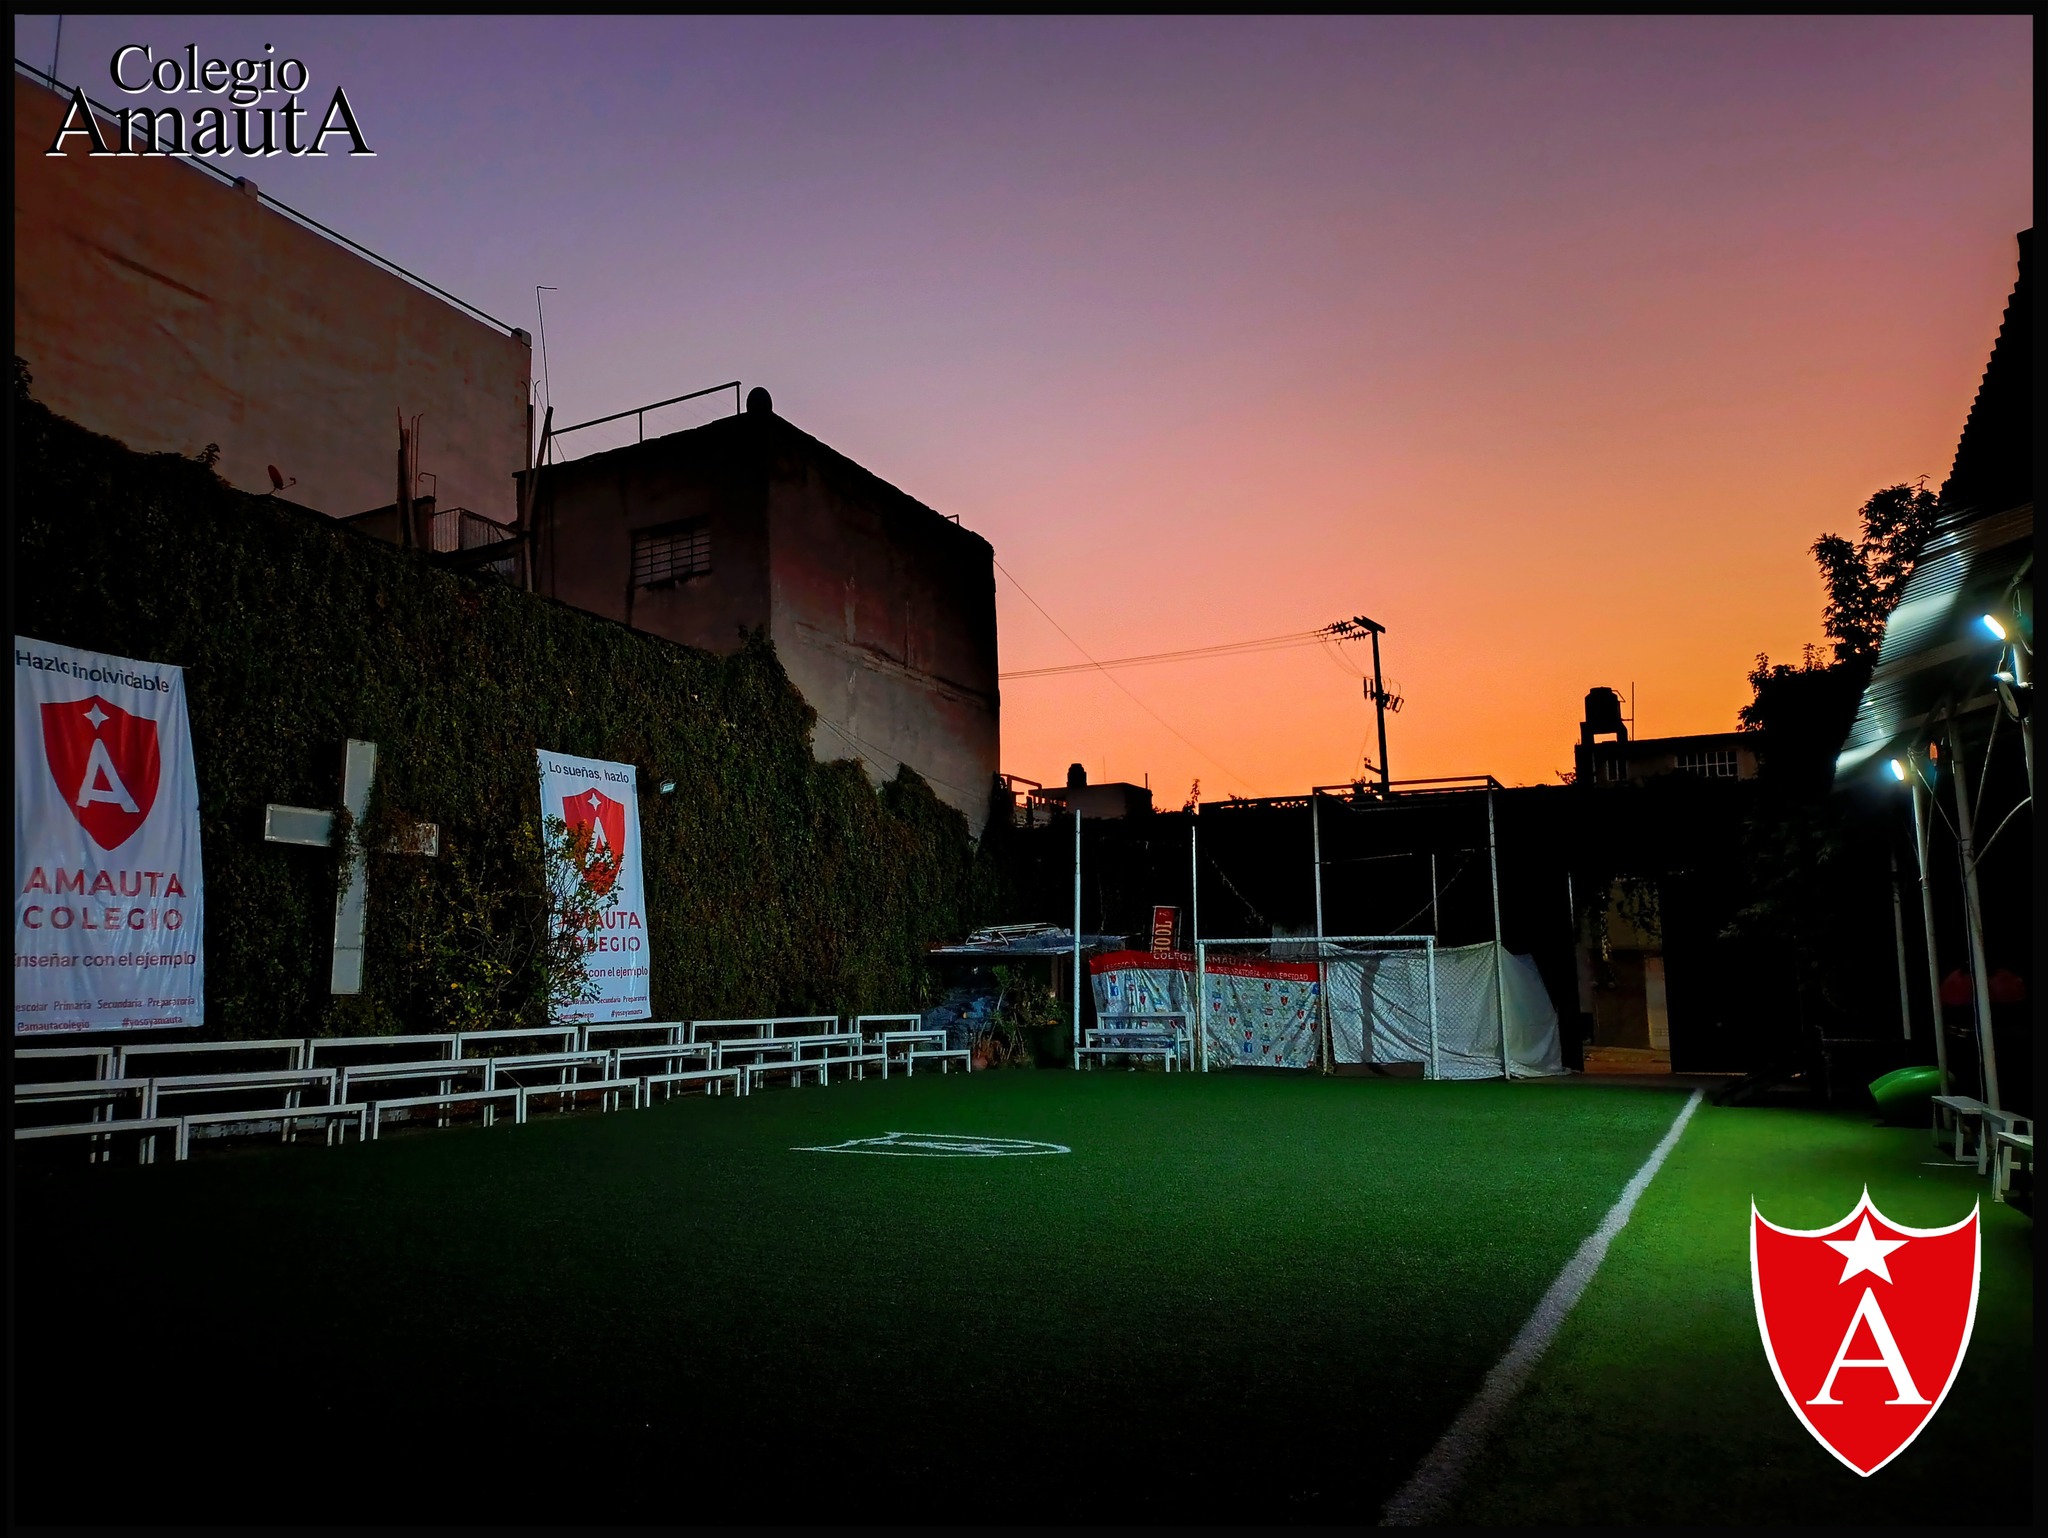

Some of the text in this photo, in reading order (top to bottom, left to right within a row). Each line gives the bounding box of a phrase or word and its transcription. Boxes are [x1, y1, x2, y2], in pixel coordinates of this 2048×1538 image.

[15, 650, 170, 693] Hazlo inolvidable
[76, 738, 140, 813] A
[548, 761, 630, 784] Lo sueñas, hazlo
[23, 866, 186, 898] AMAUTA
[23, 905, 183, 931] COLEGIO
[83, 955, 115, 968] con
[118, 952, 133, 967] el
[136, 951, 196, 969] ejemplo
[1153, 952, 1194, 963] COLEGI
[588, 969, 605, 978] con
[607, 967, 614, 977] el
[616, 965, 648, 979] ejemplo
[54, 1000, 91, 1011] Primaria
[97, 998, 142, 1010] Secundaria
